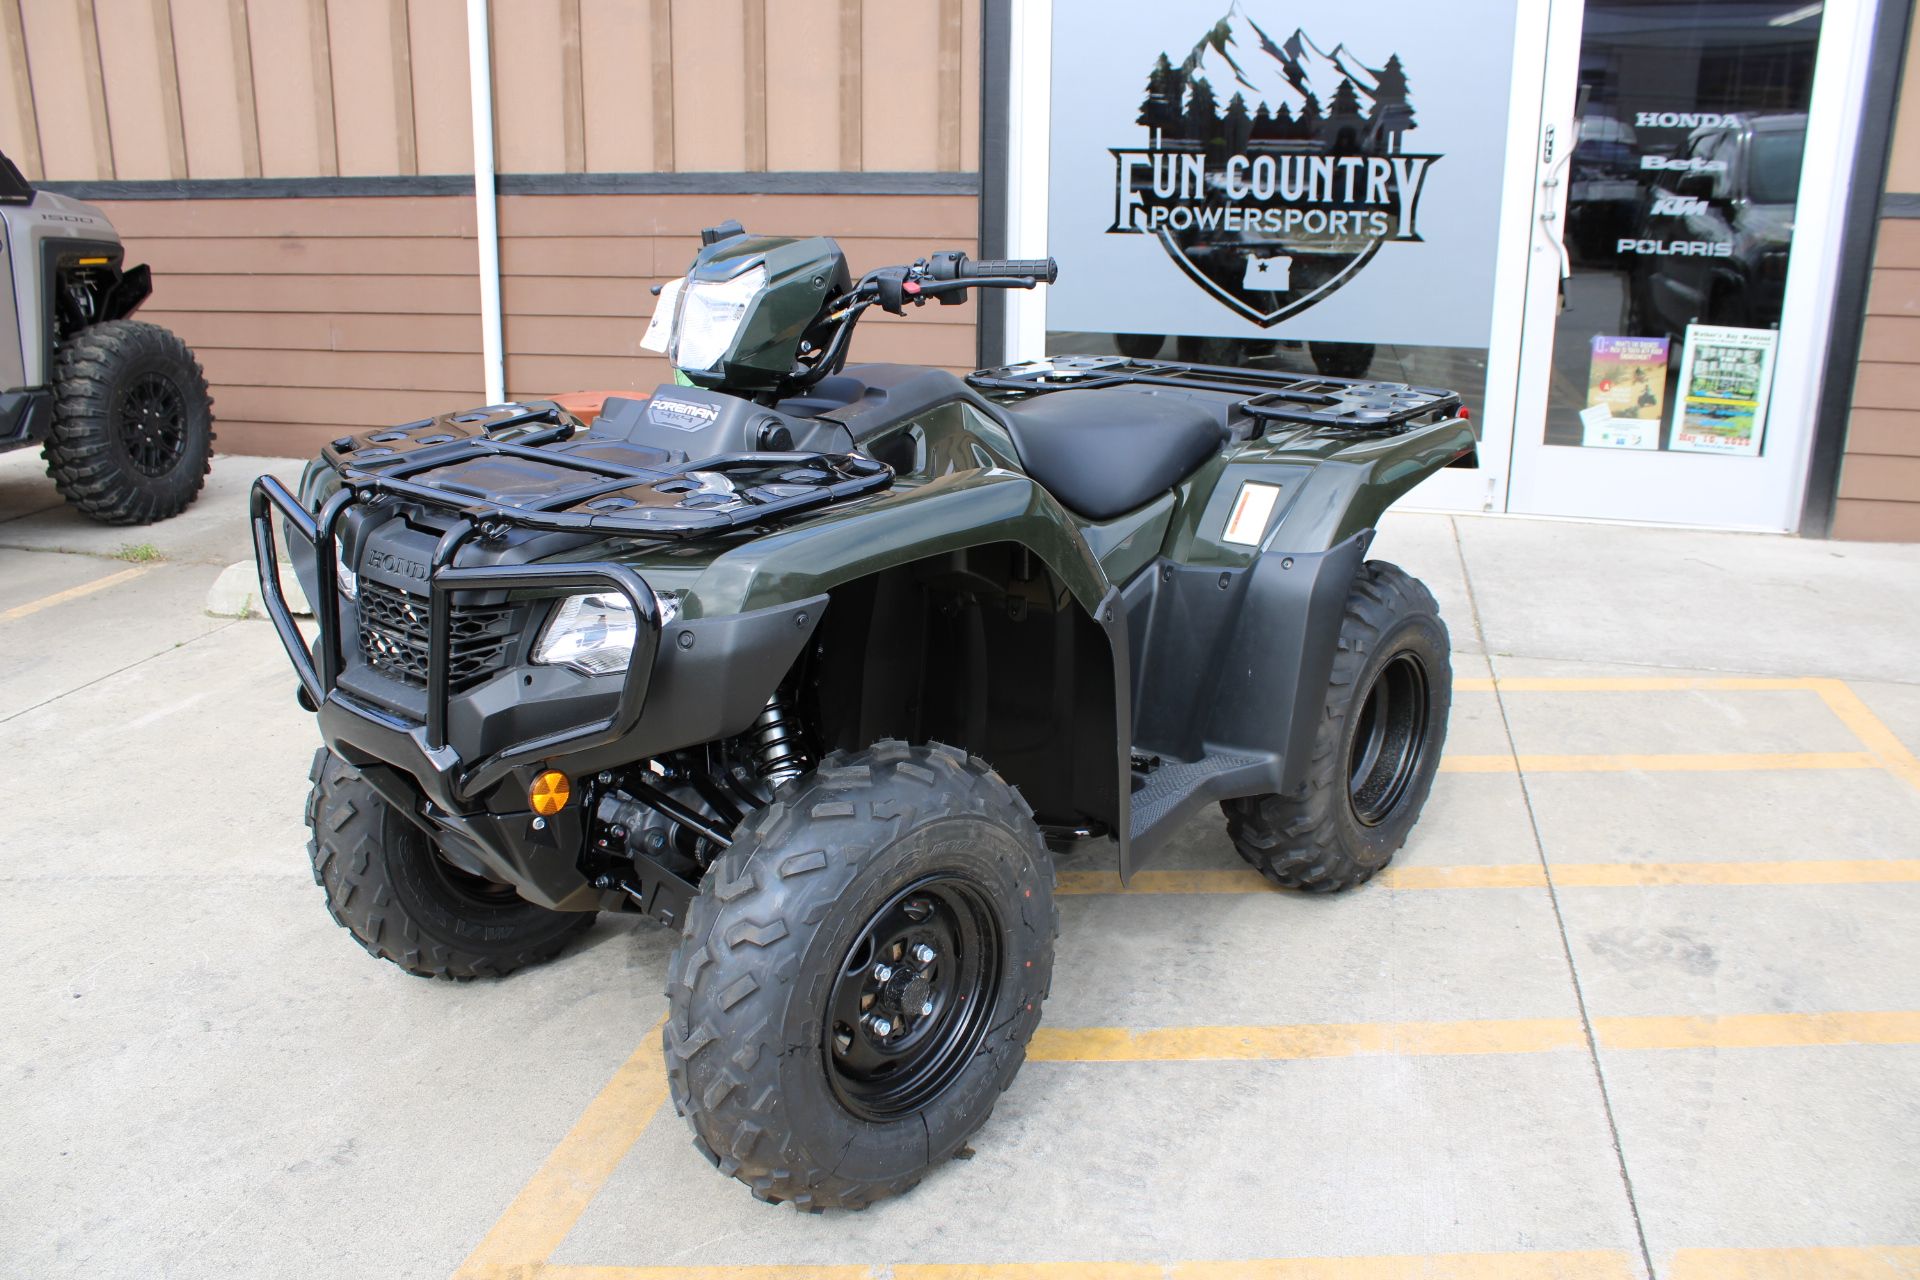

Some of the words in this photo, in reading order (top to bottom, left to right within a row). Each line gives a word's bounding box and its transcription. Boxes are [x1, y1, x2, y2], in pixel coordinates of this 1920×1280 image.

[1634, 111, 1743, 129] HONDA
[1640, 155, 1728, 172] Beta
[1116, 152, 1206, 230] FUN
[1226, 154, 1430, 238] COUNTRY
[1650, 196, 1710, 216] KTM
[42, 213, 95, 225] 1500
[1151, 205, 1389, 236] POWERSPORTS
[1616, 238, 1733, 258] POLARIS
[649, 400, 719, 422] FOREMAN
[368, 549, 430, 584] HOND
